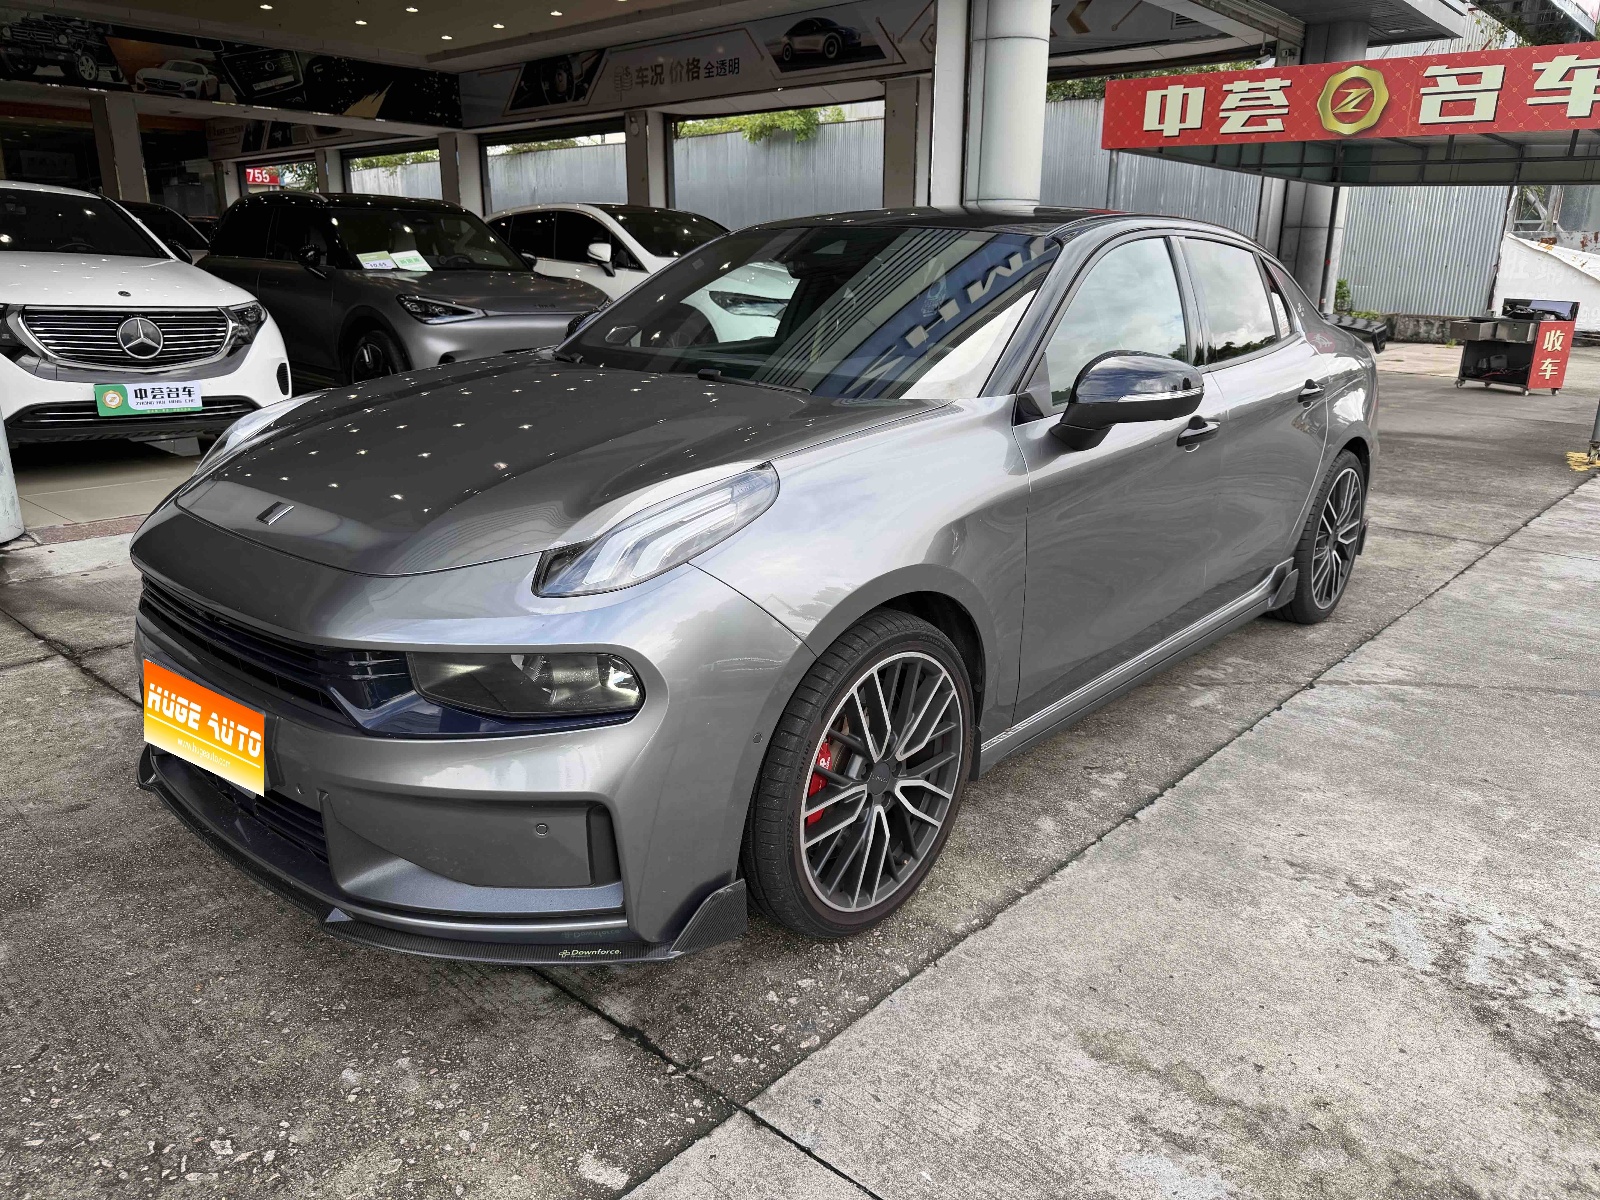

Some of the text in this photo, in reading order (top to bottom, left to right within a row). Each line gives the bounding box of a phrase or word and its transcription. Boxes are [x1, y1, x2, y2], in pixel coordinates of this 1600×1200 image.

[635, 57, 740, 88] 车况 价格 全透明
[1143, 78, 1293, 137] 中荟
[1419, 54, 1600, 124] 名车
[1538, 329, 1566, 380] 收车
[133, 386, 196, 400] 中荟名车
